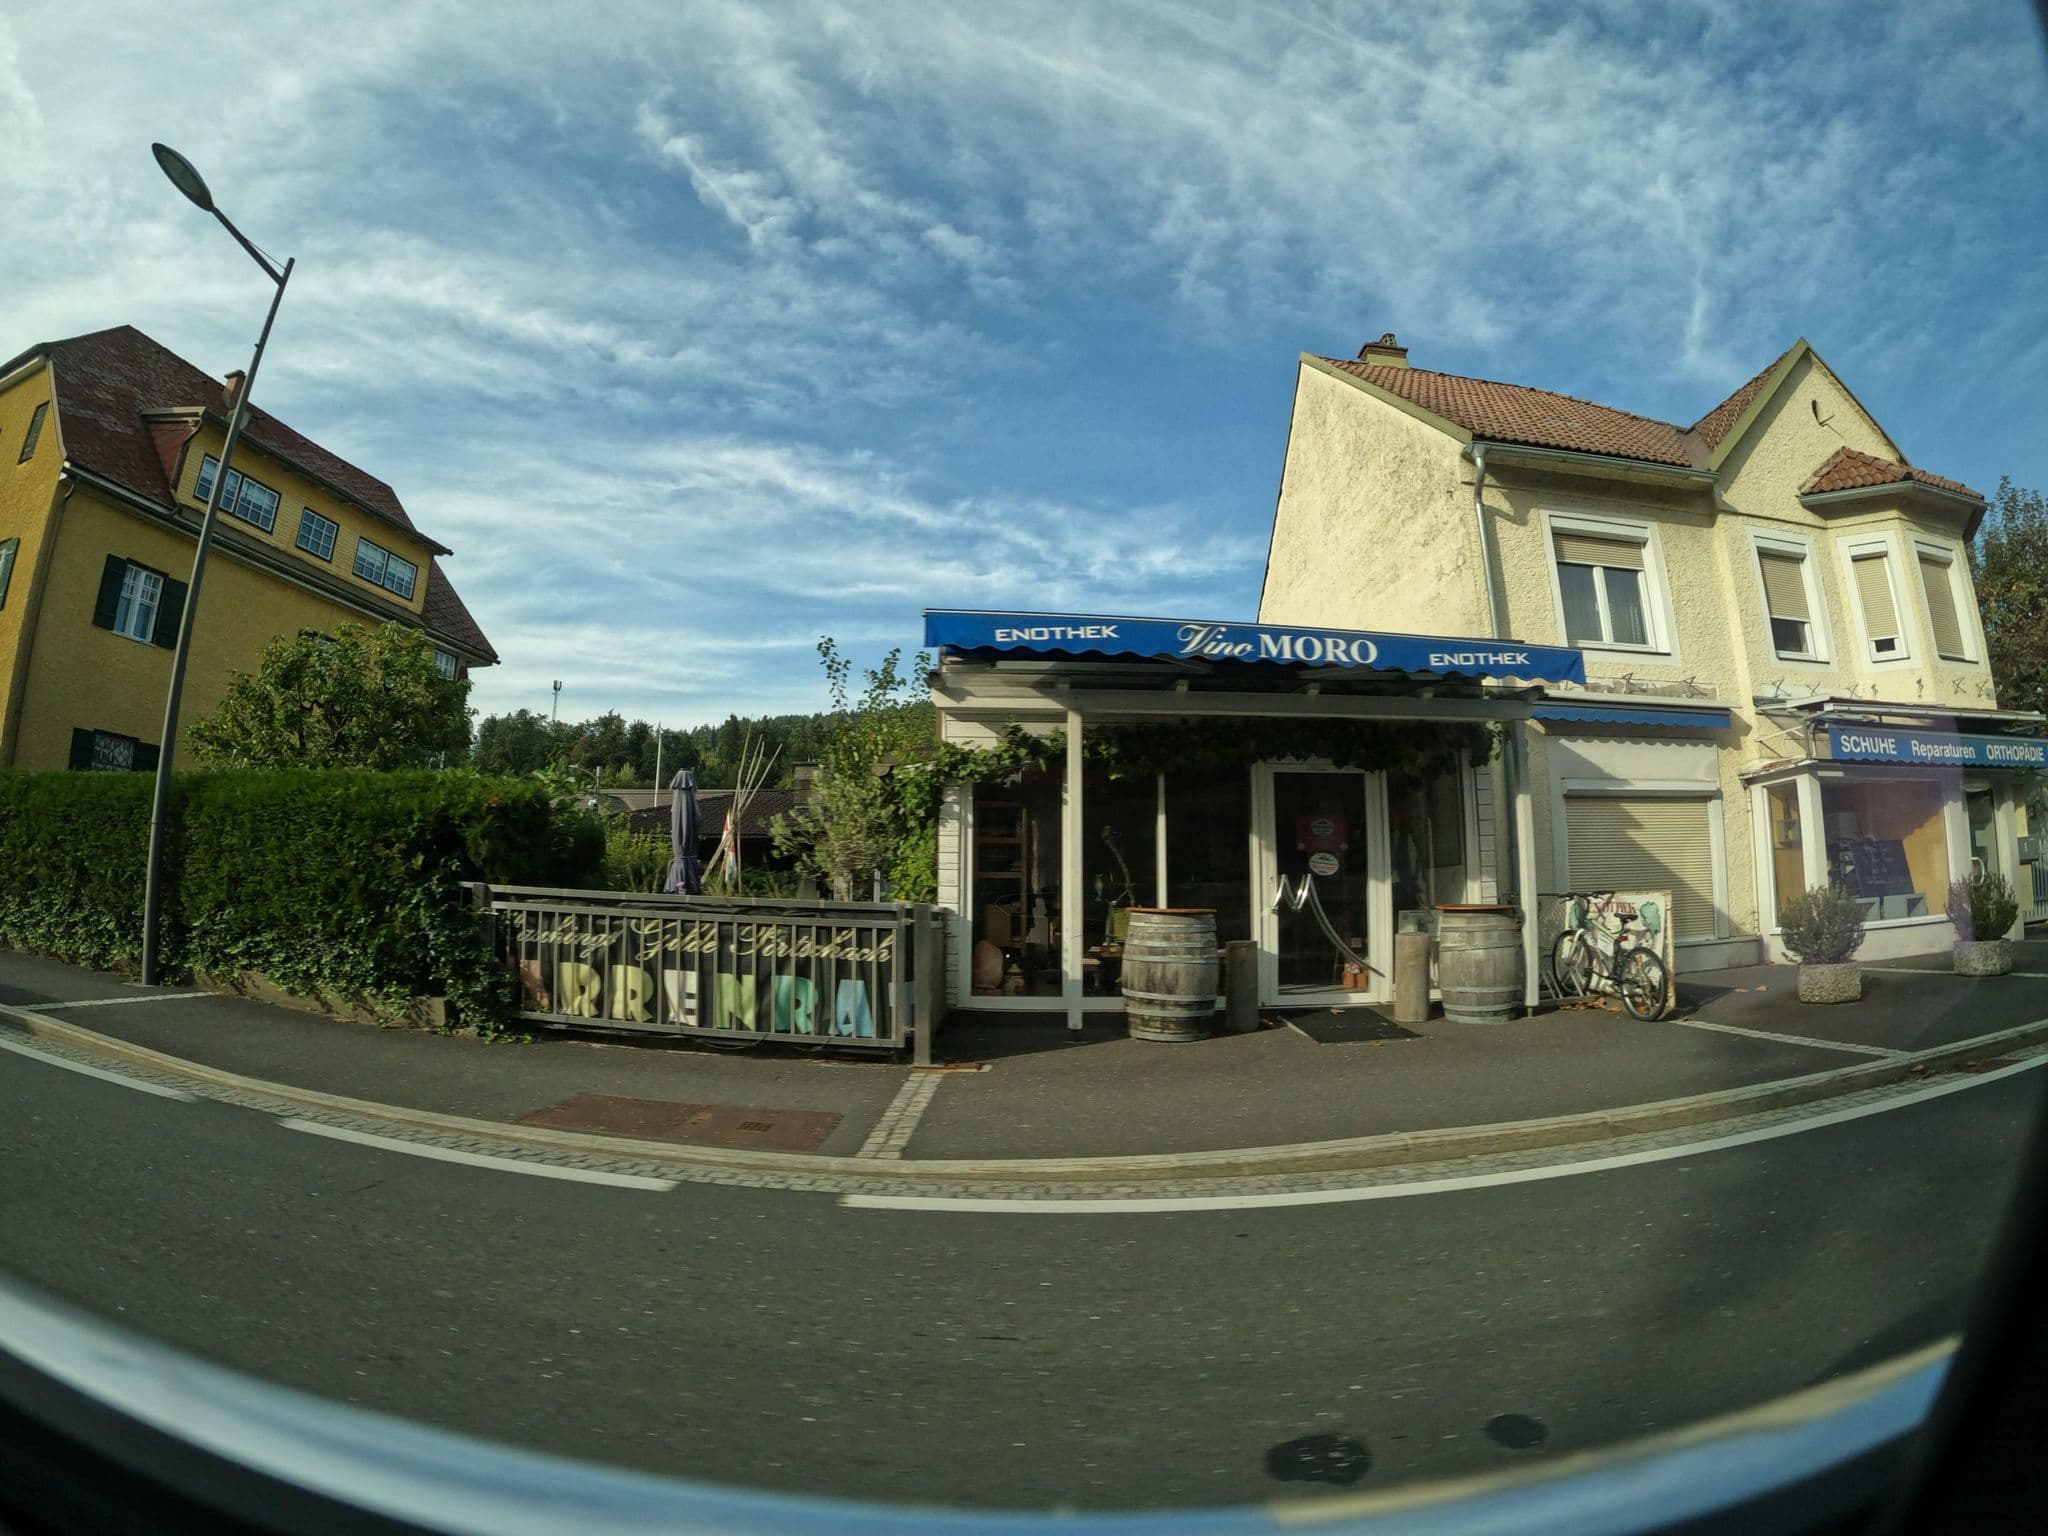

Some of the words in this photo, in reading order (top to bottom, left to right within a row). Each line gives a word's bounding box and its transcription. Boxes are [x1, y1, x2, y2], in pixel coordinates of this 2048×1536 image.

[994, 625, 1120, 642] ENOTHEK
[1177, 624, 1254, 657] Vino
[1258, 633, 1378, 664] MORO
[1429, 652, 1530, 666] ENOTHEK
[1840, 735, 1898, 755] SCHUHE
[1911, 740, 1976, 760] Reparaturen
[1986, 742, 2045, 762] ORTHOPÄDIE
